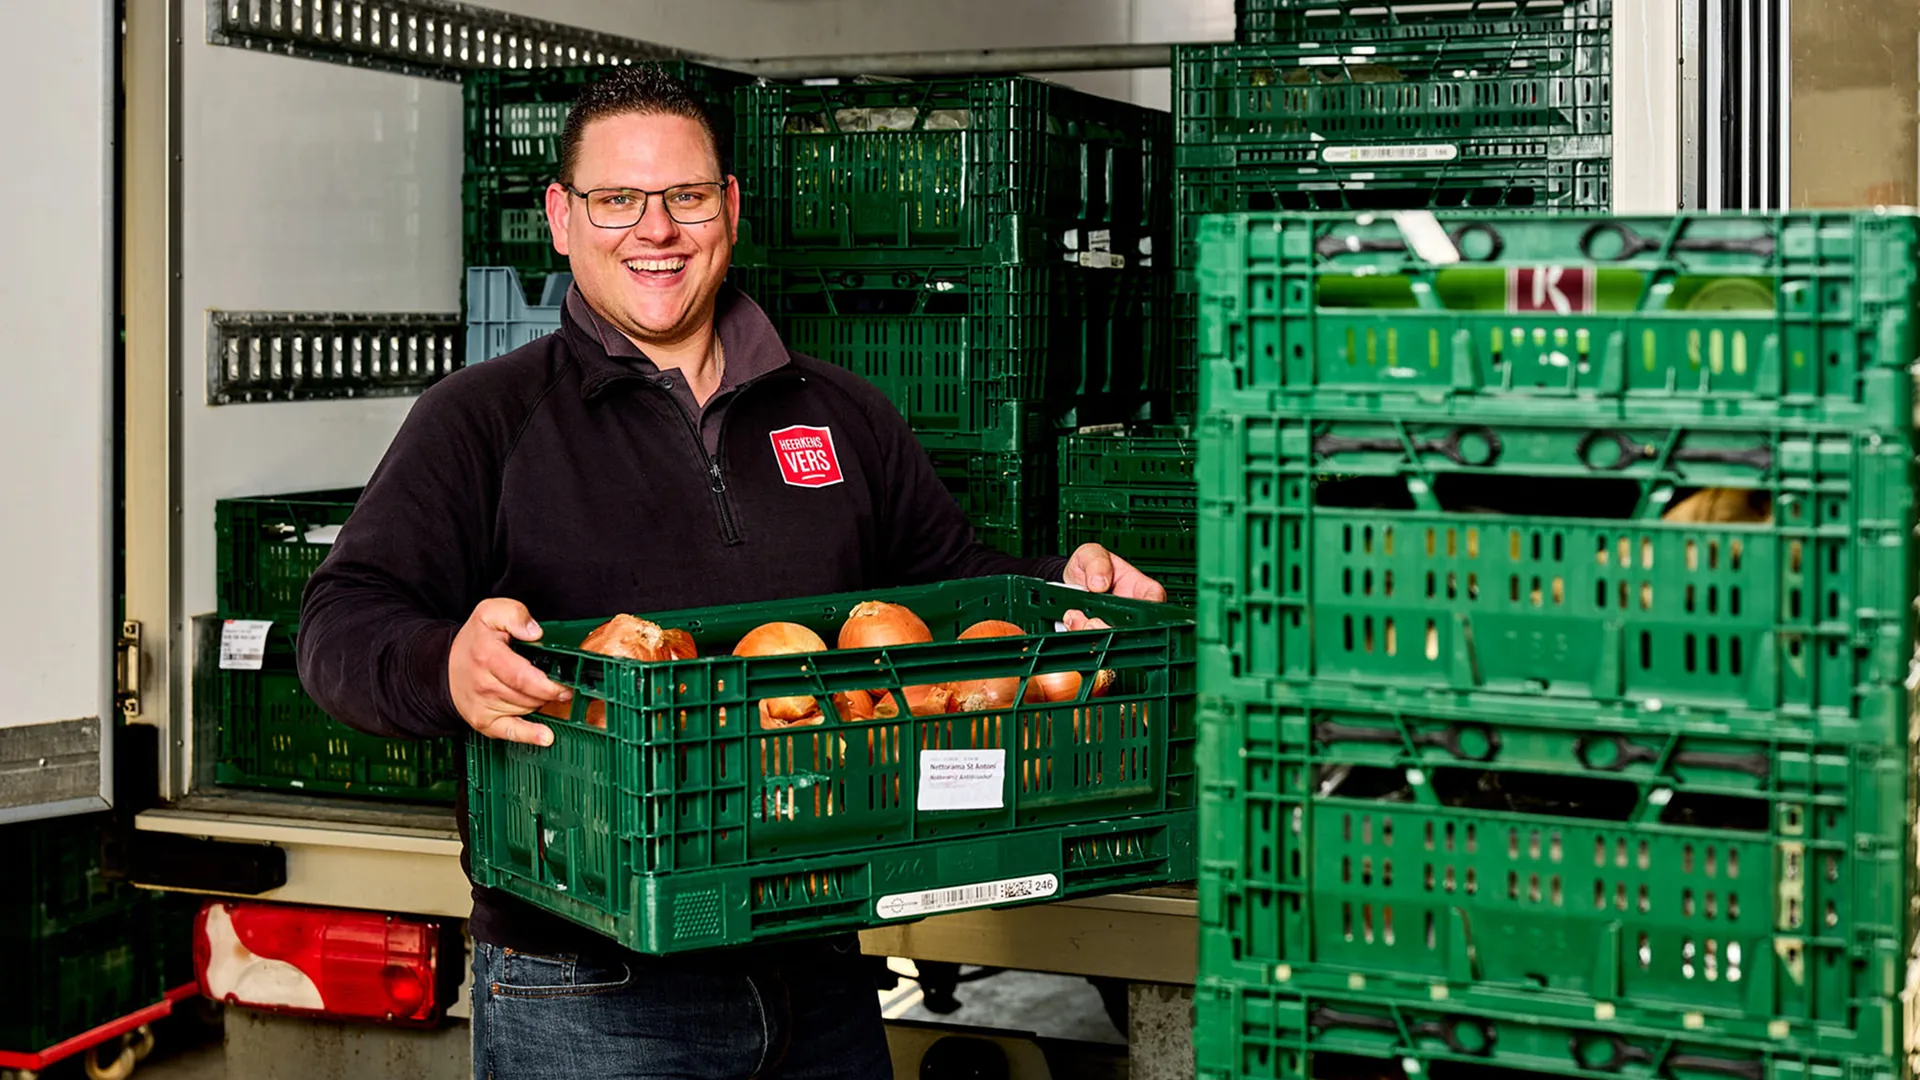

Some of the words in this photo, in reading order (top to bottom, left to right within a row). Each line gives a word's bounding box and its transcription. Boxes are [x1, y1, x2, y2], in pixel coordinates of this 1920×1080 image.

[1532, 264, 1572, 316] K
[779, 436, 823, 451] HEERKENS
[783, 449, 831, 473] VERS
[1035, 879, 1053, 891] 246
